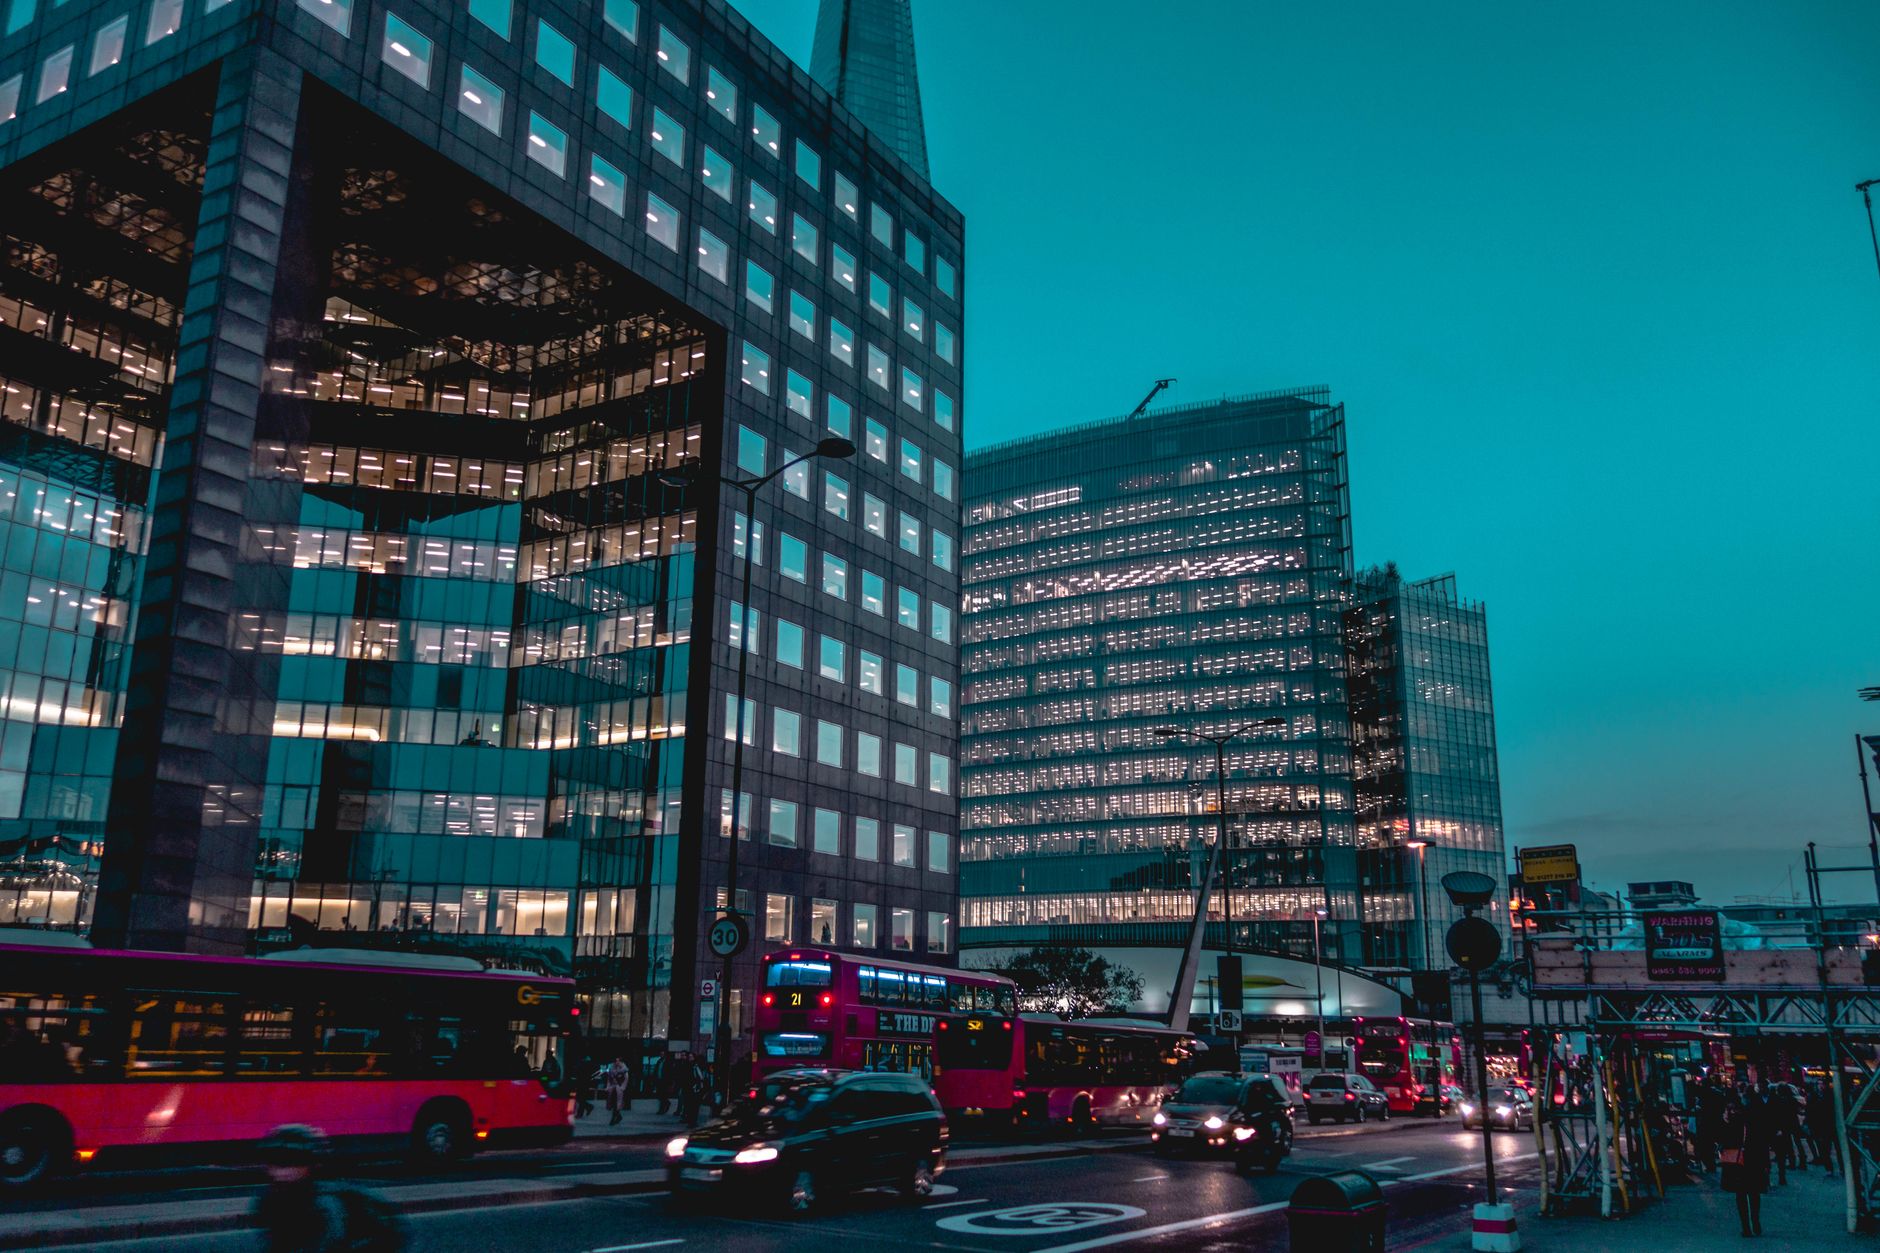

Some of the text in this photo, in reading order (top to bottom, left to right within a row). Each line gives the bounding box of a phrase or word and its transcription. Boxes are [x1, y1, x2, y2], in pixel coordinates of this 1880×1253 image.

[713, 928, 738, 946] 30
[791, 992, 802, 1006] 21
[894, 1013, 919, 1032] THE
